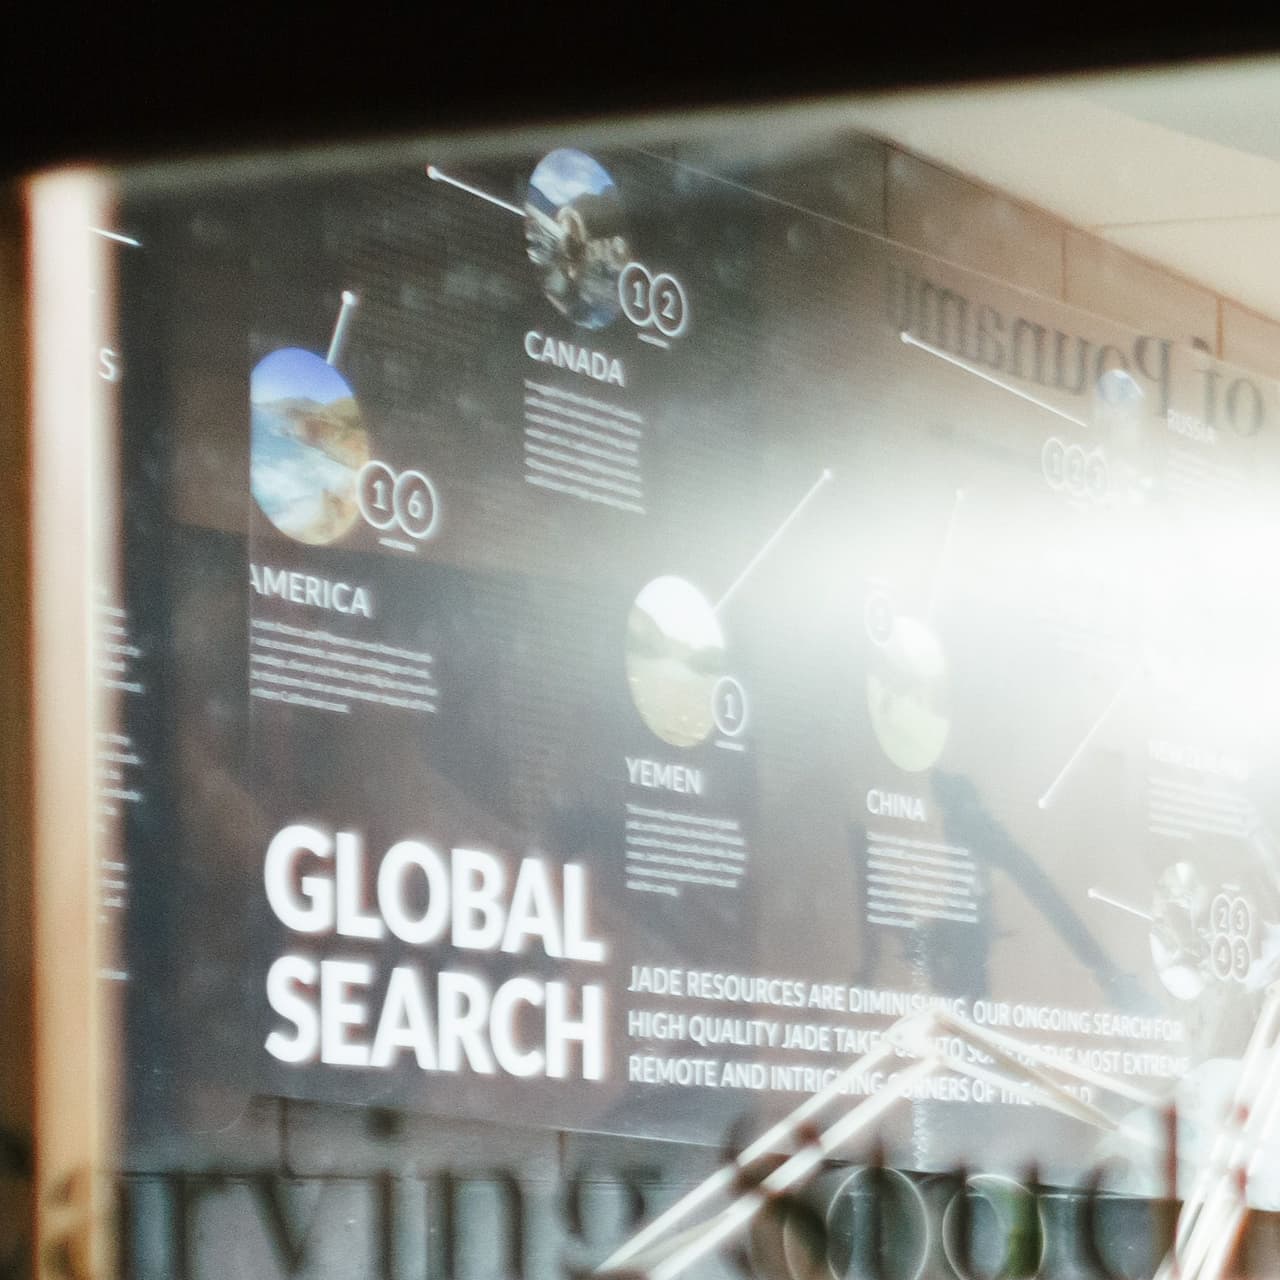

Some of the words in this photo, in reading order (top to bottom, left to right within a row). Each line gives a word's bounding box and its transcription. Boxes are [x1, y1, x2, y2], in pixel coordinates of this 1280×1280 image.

[524, 330, 626, 388] CANADA
[250, 562, 374, 618] AMERICA
[625, 756, 704, 796] YEMEN
[866, 788, 927, 823] CHINA
[264, 823, 607, 964] GLOBAL
[264, 955, 605, 1082] SEARCH
[627, 965, 683, 997] JADE
[687, 970, 803, 1009] RESOURCES
[807, 983, 846, 1012] ARE
[972, 1000, 1011, 1027] OUR
[1012, 1004, 1092, 1034] ONGOING
[1093, 1012, 1151, 1040] SEARCH
[1153, 1019, 1185, 1042] FOR
[628, 1010, 686, 1042] HIGH
[689, 1015, 778, 1048] QUALITY
[781, 1024, 831, 1052] JADE
[628, 1055, 719, 1087] REMOTE
[720, 1061, 765, 1091] AND
[971, 1079, 995, 1103] OF
